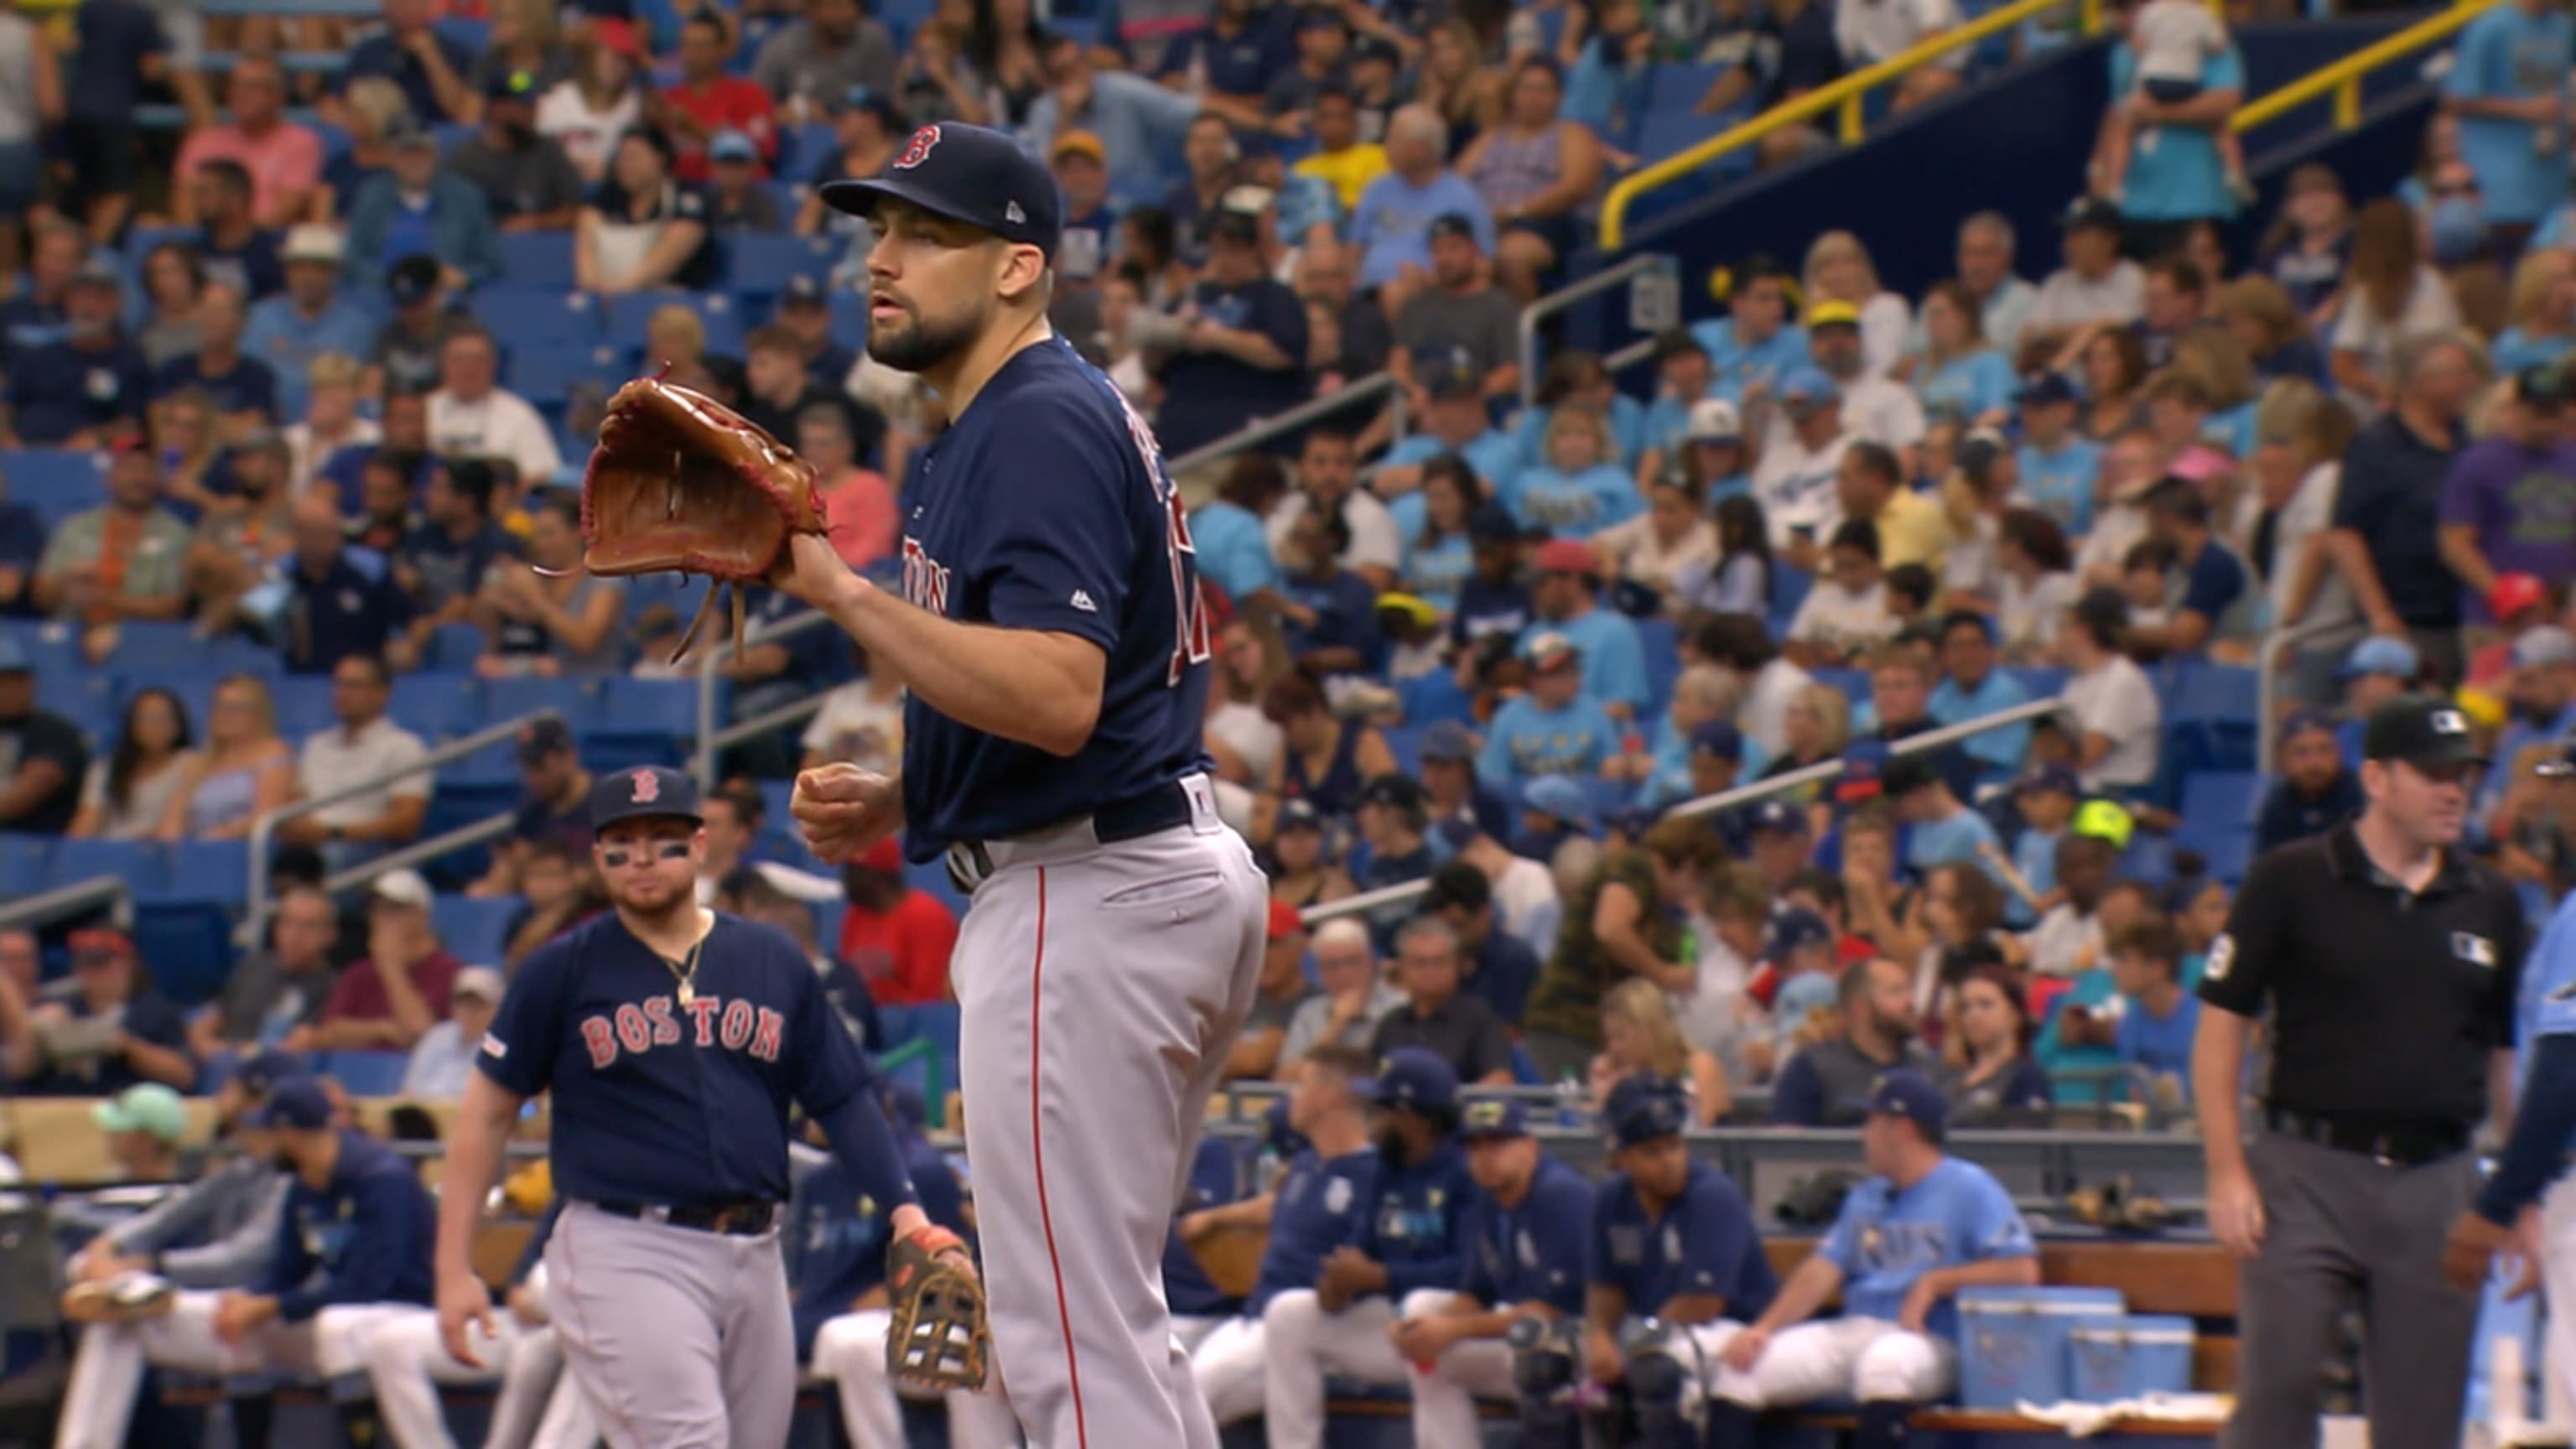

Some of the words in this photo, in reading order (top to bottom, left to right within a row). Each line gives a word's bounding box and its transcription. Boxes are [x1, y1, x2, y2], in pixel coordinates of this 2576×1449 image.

[893, 125, 941, 169] B
[631, 770, 660, 803] B
[580, 995, 784, 1069] BOSTON
